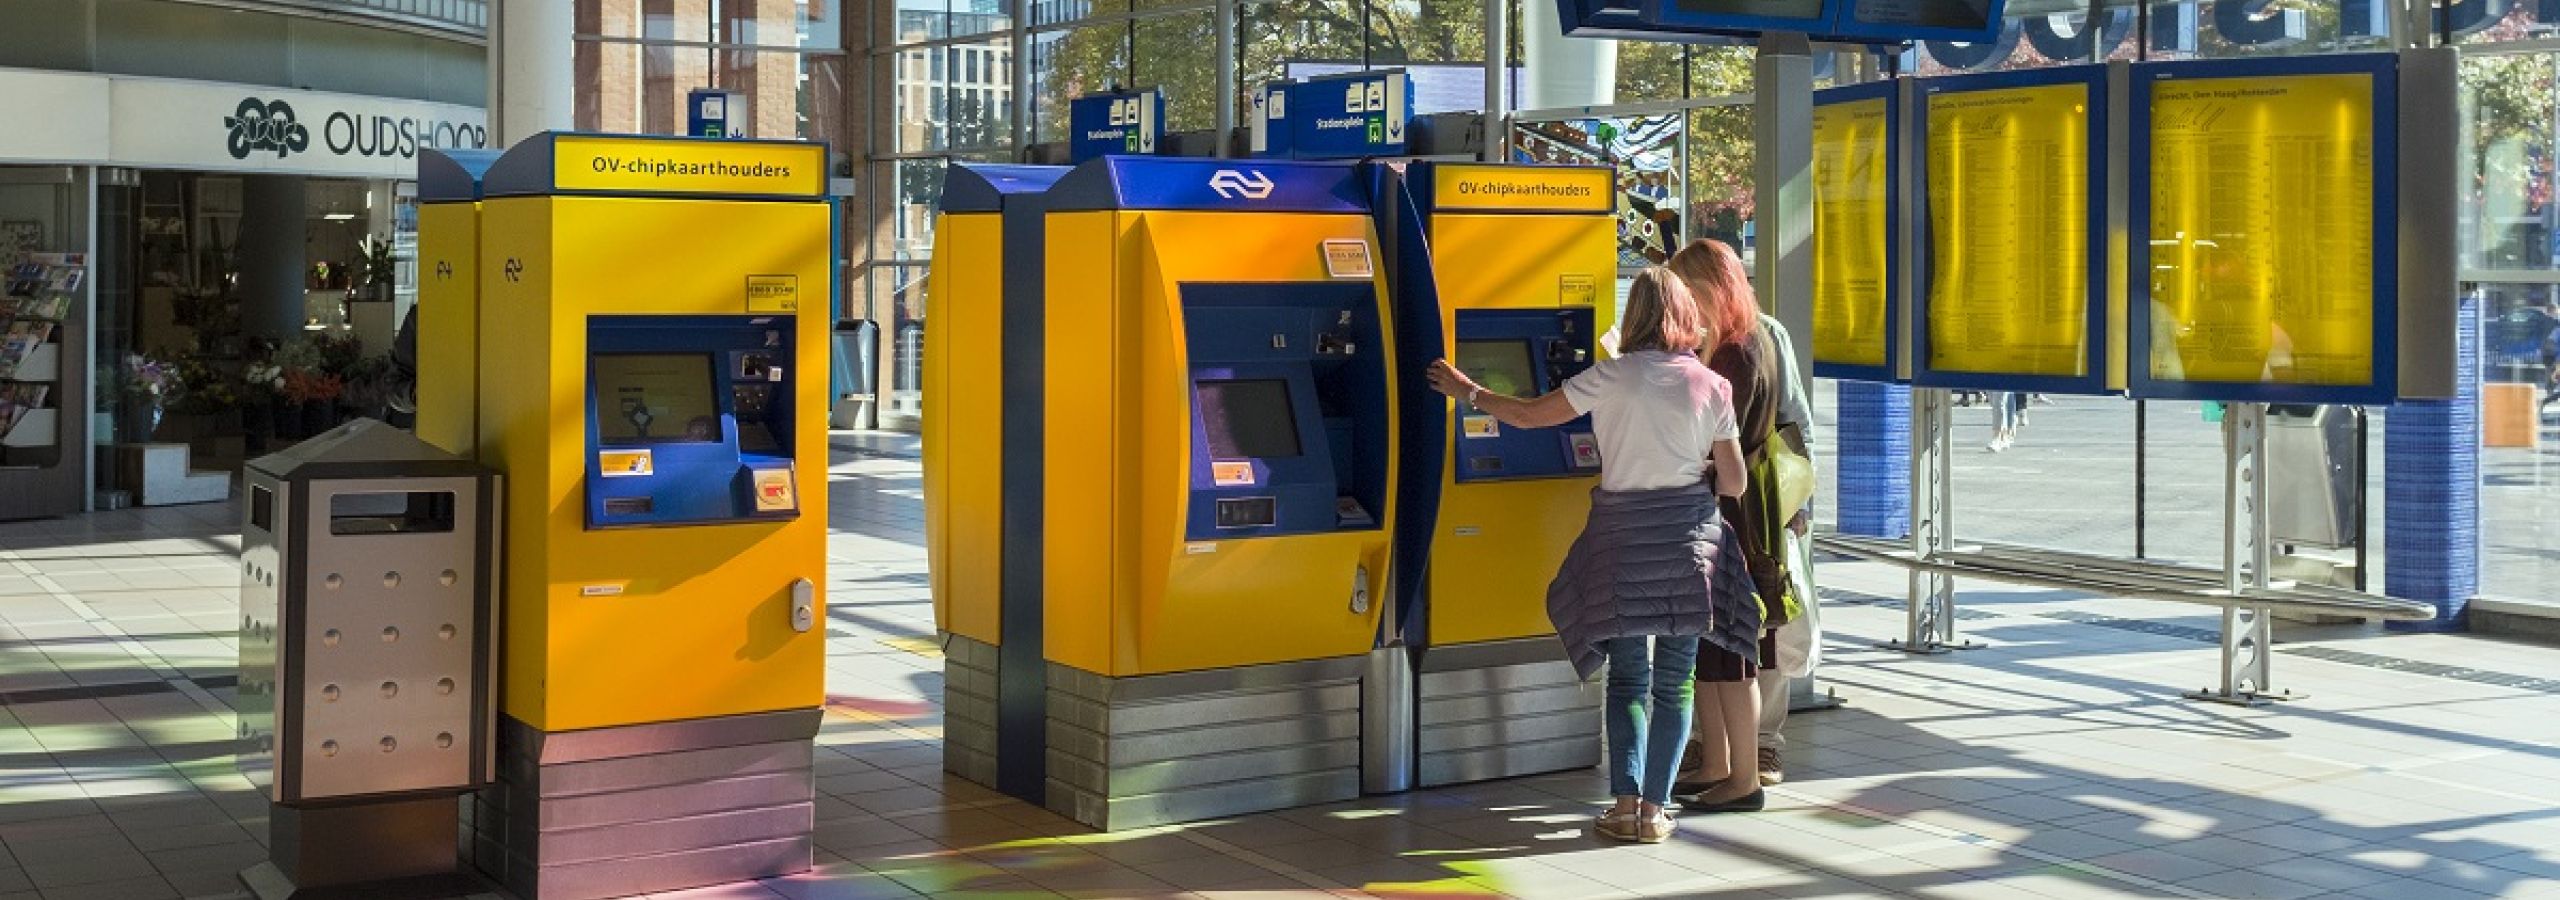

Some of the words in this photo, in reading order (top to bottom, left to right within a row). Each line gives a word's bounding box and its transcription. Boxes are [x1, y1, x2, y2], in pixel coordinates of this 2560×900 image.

[1316, 116, 1364, 130] Stationsplein
[592, 156, 790, 177] OV-chipkaarthouders
[1458, 180, 1591, 197] OV-chipkaarthouders
